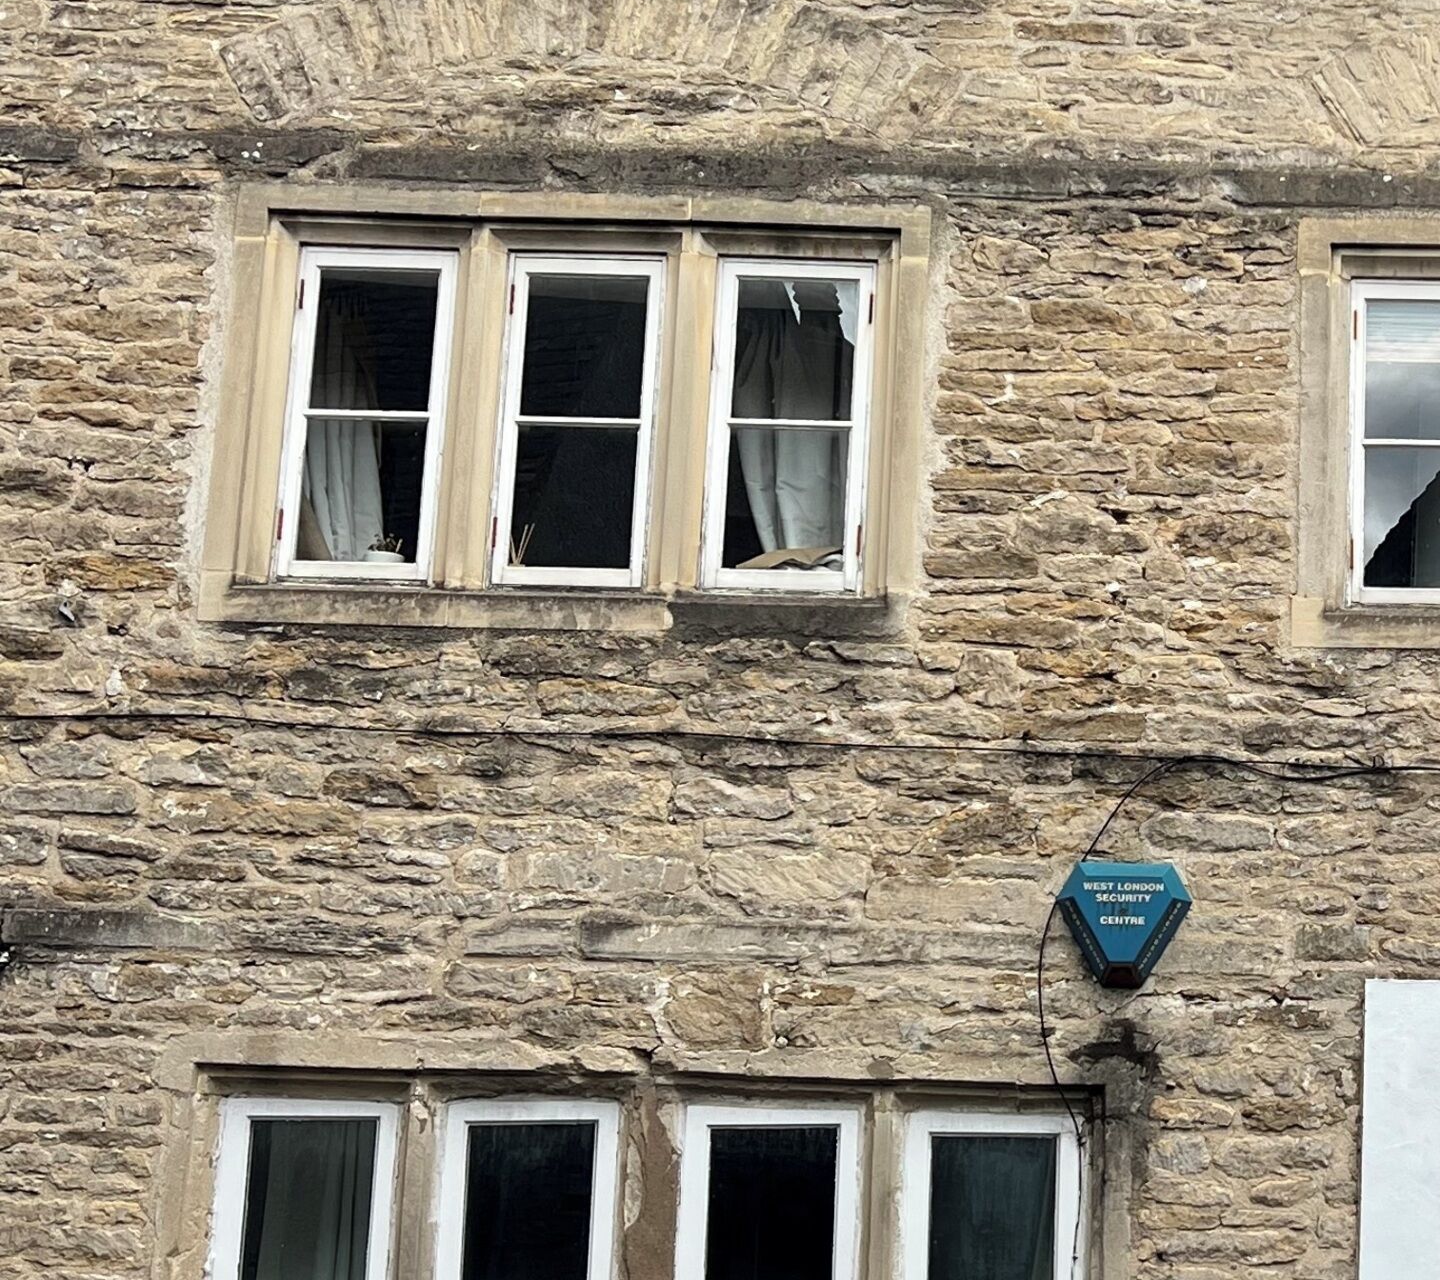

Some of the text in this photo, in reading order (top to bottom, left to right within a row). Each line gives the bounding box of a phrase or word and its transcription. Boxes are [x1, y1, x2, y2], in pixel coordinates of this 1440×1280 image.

[1083, 882, 1164, 892] WEST LONDON
[1095, 893, 1152, 902] SECURITY
[1099, 916, 1146, 926] CENTRE
